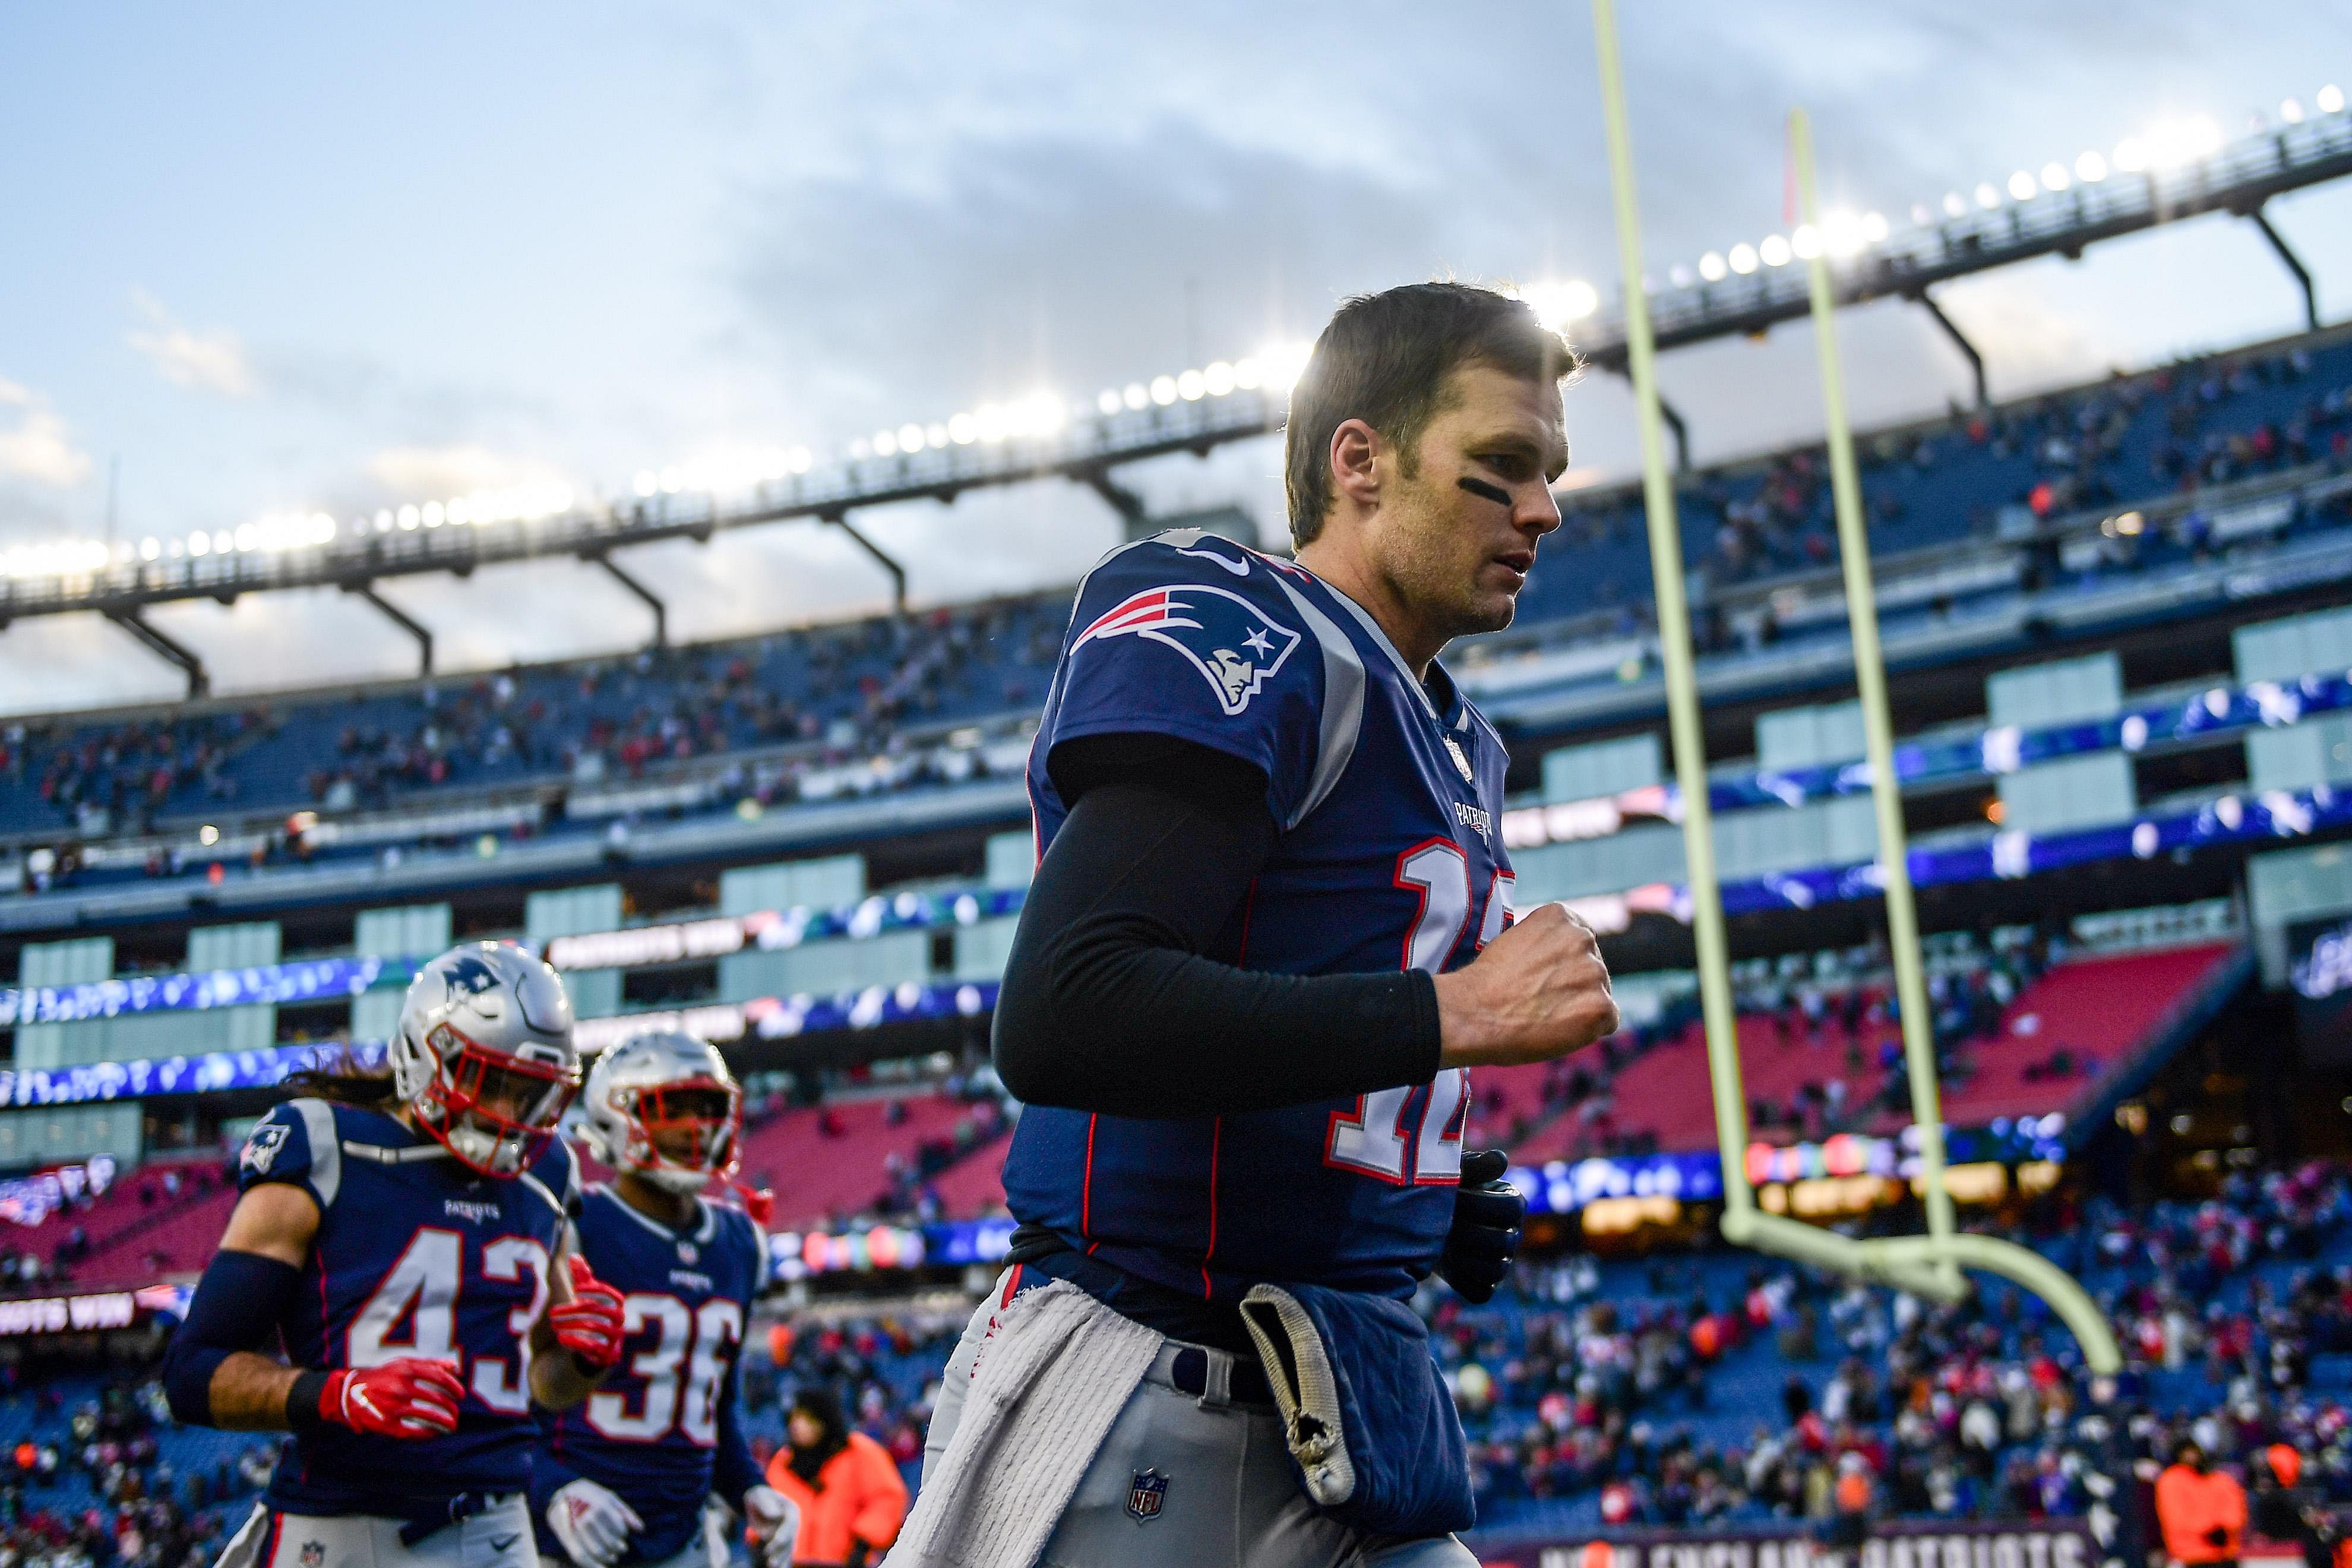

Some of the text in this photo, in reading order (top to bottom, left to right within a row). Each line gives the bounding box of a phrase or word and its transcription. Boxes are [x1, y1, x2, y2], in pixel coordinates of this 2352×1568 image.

[1454, 802, 1493, 837] PATRIOT
[1322, 836, 1516, 1186] 12
[344, 1225, 551, 1417] 43
[584, 1290, 742, 1448] 36
[1131, 1489, 1162, 1515] NFL
